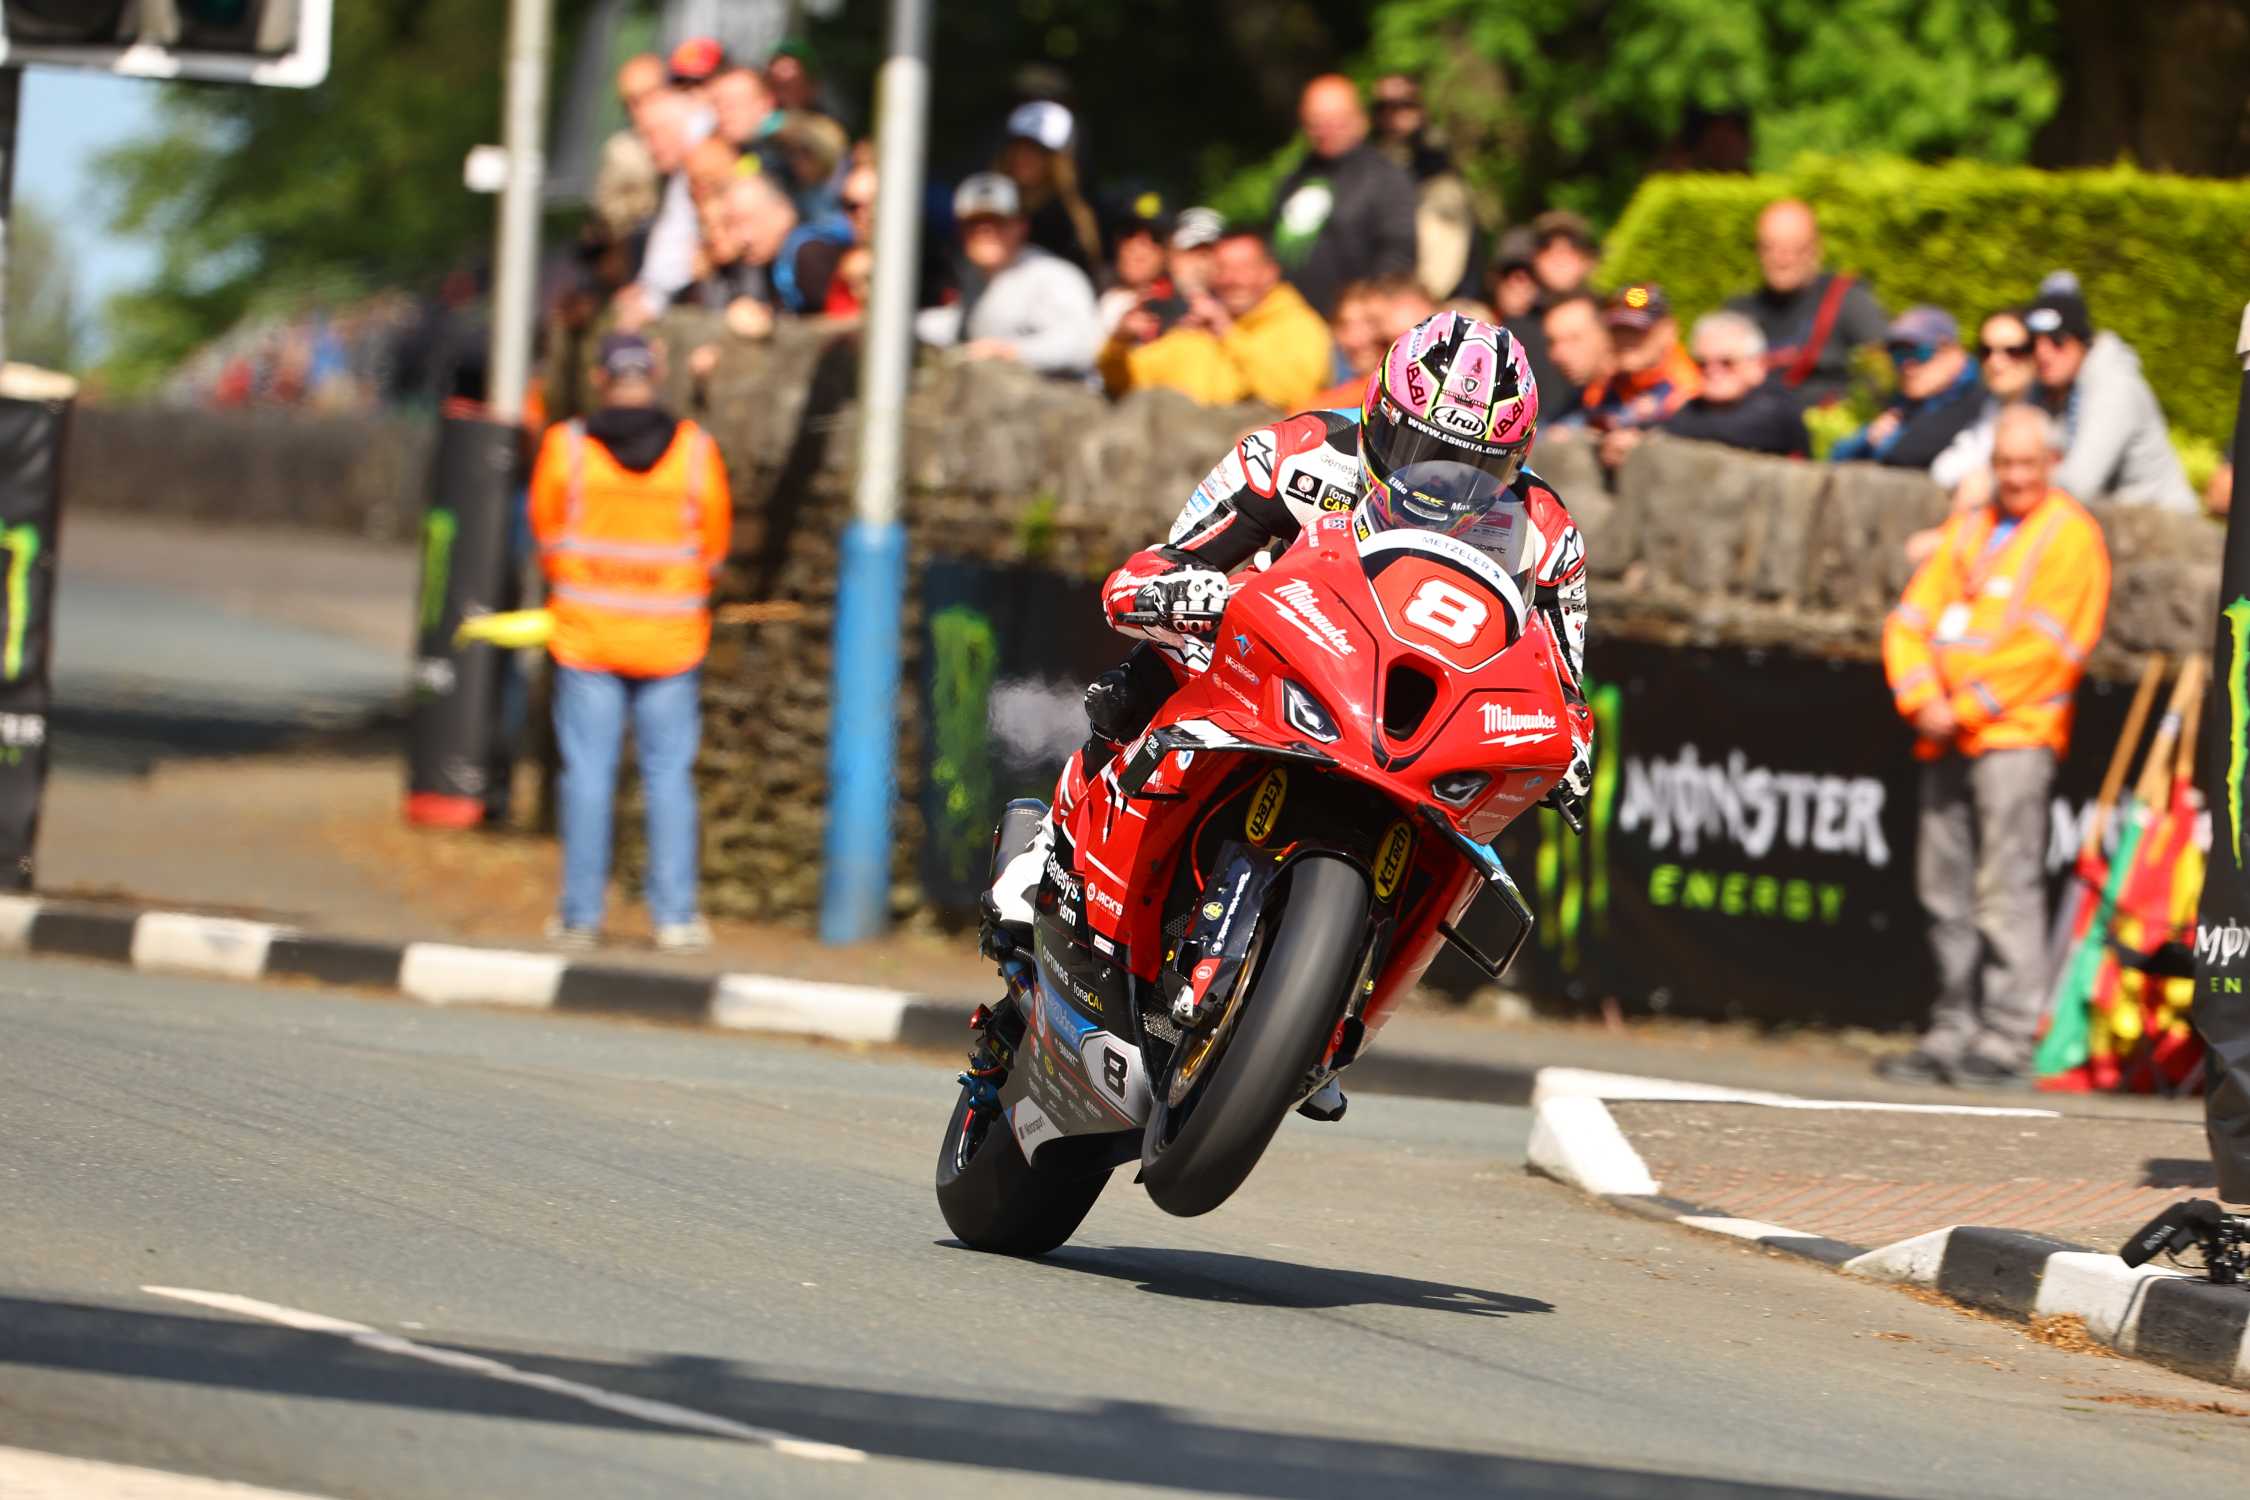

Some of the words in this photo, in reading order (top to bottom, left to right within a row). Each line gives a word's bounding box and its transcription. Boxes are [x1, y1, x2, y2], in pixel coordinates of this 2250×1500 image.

[1407, 416, 1508, 456] WWW.ESKUTA.COM
[1438, 409, 1480, 432] Arai
[1328, 487, 1352, 504] fona
[1421, 536, 1490, 571] METZELER
[1273, 578, 1357, 656] Milwaukee
[1404, 579, 1490, 646] 8
[1477, 701, 1558, 735] Milwaukee
[1619, 741, 1890, 867] MONSTER
[1648, 862, 1846, 925] ENERGY
[1042, 945, 1070, 987] OPTIMAS
[1103, 1046, 1129, 1101] 8
